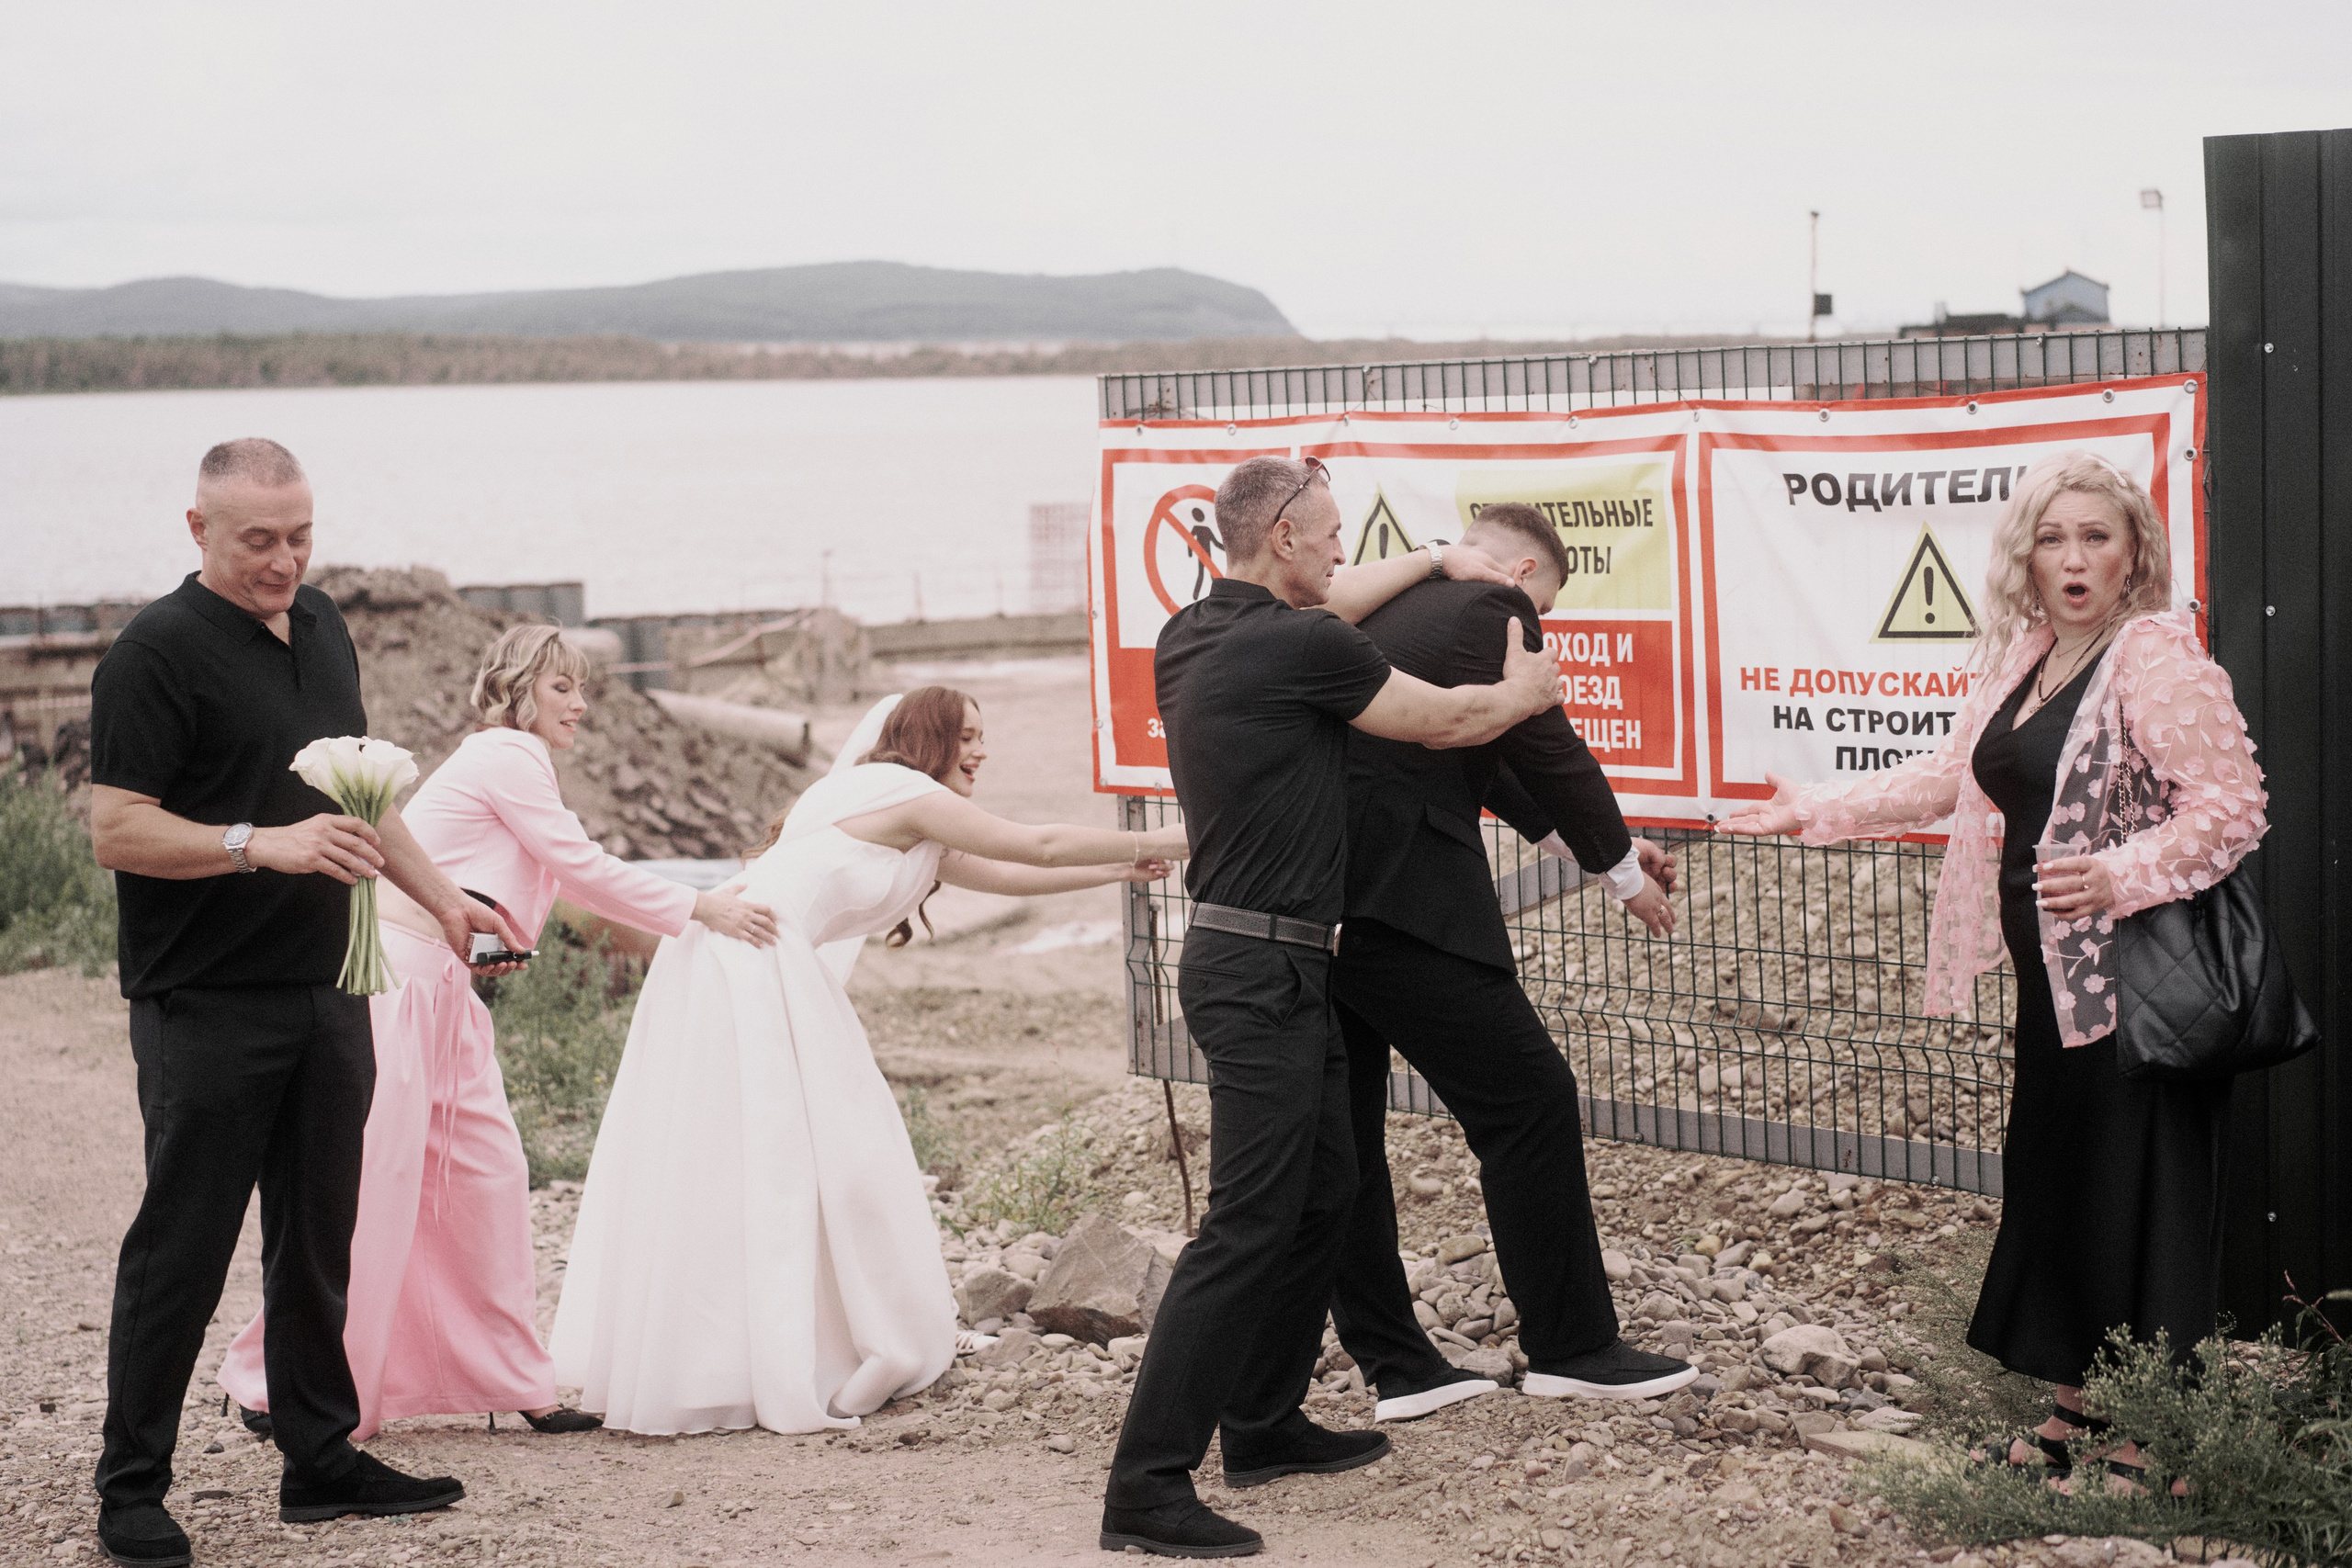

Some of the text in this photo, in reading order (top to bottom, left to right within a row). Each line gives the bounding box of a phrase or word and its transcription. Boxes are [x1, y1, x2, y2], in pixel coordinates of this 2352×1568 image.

[1616, 633, 1634, 663] И
[1740, 666, 1978, 698] НЕ ДОПУСКАЙ
[1773, 705, 1956, 736] НА СТРОИТ
[1836, 746, 1935, 772] ПЛО
